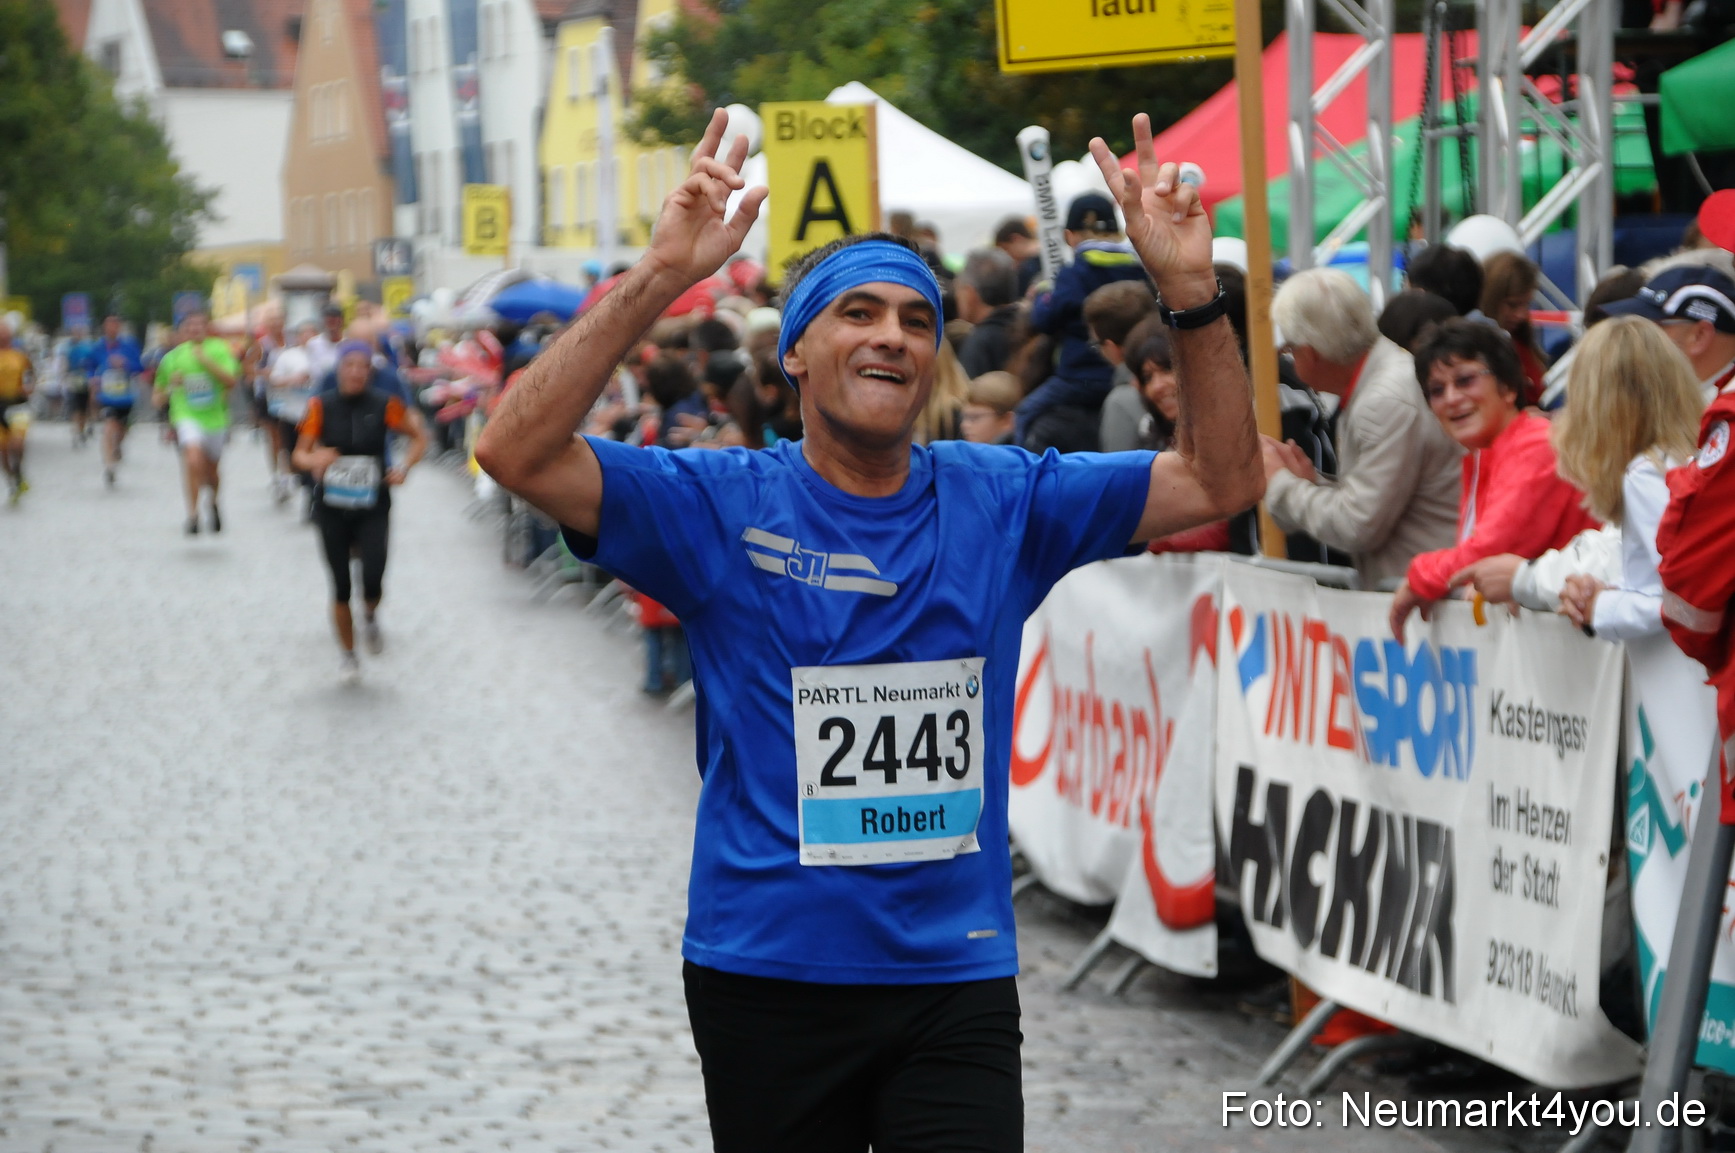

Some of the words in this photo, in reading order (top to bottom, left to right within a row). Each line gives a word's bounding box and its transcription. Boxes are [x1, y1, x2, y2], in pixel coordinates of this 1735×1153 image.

[776, 108, 867, 141] Block
[794, 158, 854, 241] A
[1034, 173, 1058, 221] BMW
[476, 206, 497, 240] B
[798, 686, 868, 705] PARTL
[873, 681, 961, 703] Neumarkt
[818, 708, 971, 787] 2443
[806, 784, 815, 796] B
[1490, 779, 1511, 831] Im
[860, 803, 946, 835] Robert
[1492, 845, 1517, 895] der
[1487, 938, 1534, 998] 92318
